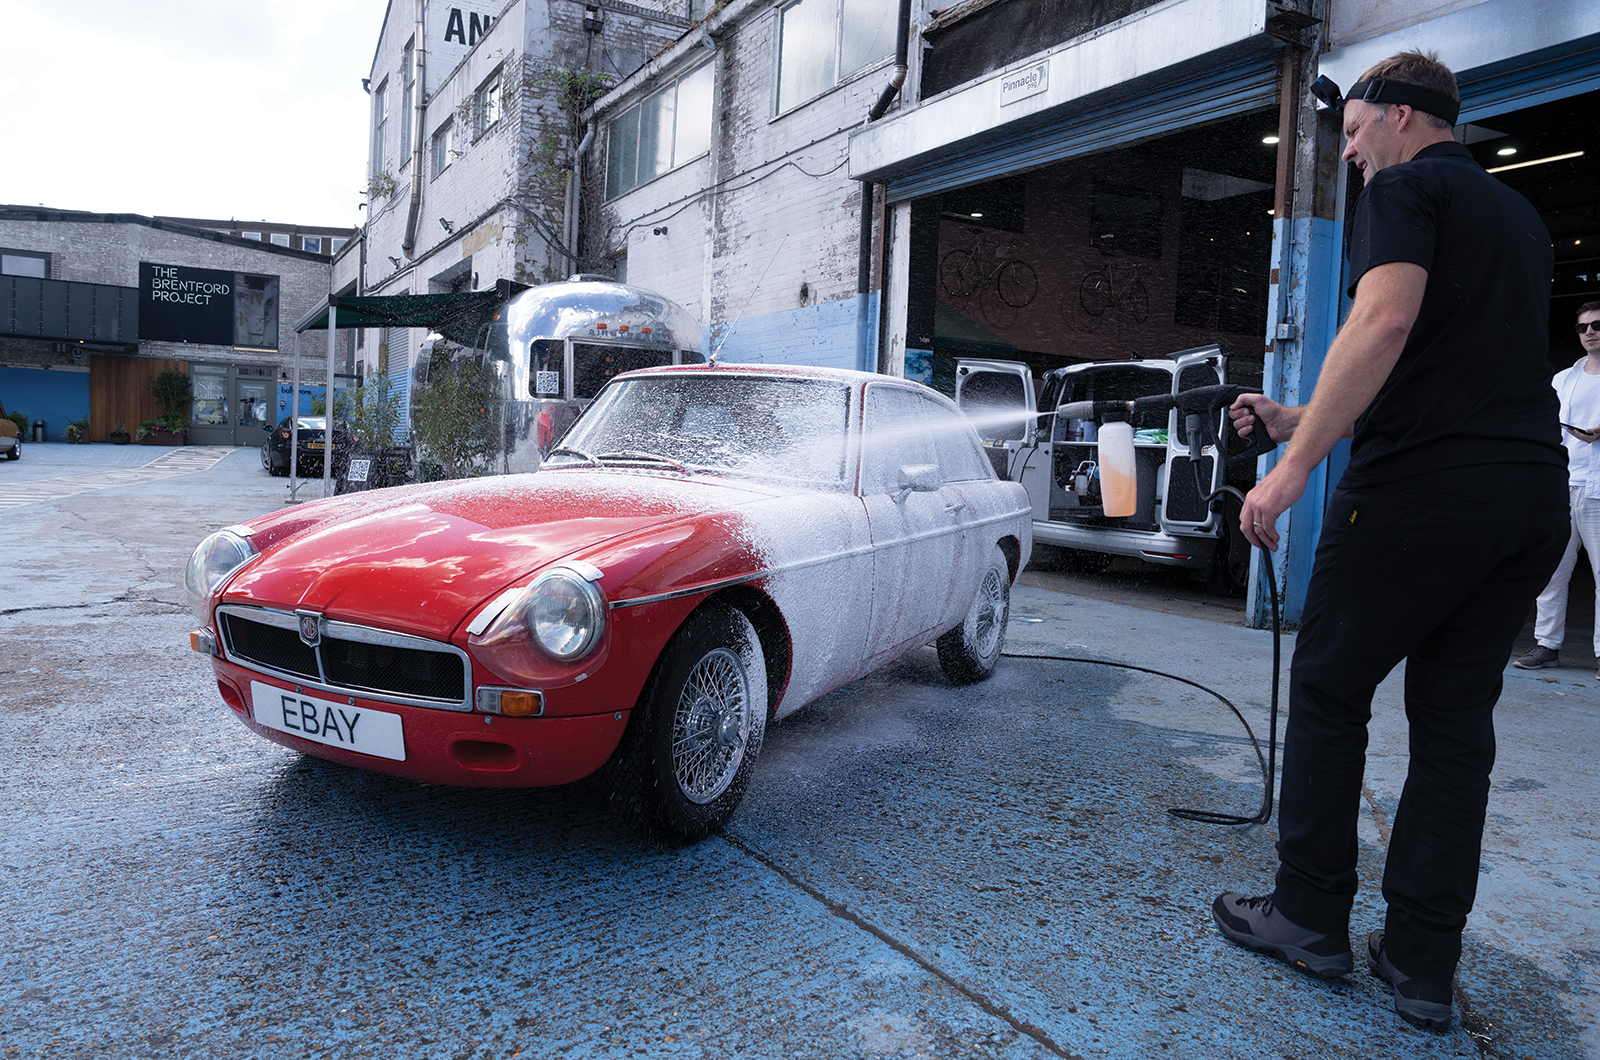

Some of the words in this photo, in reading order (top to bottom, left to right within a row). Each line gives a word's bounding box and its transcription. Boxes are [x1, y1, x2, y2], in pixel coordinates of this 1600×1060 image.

[444, 7, 497, 46] AN
[1003, 72, 1037, 93] Pinnacle
[152, 265, 178, 279] THE
[152, 278, 230, 295] BRENTFORD
[152, 290, 212, 305] PROJECT
[198, 381, 223, 391] Sales
[303, 619, 317, 637] MG
[281, 695, 361, 744] EBAY
